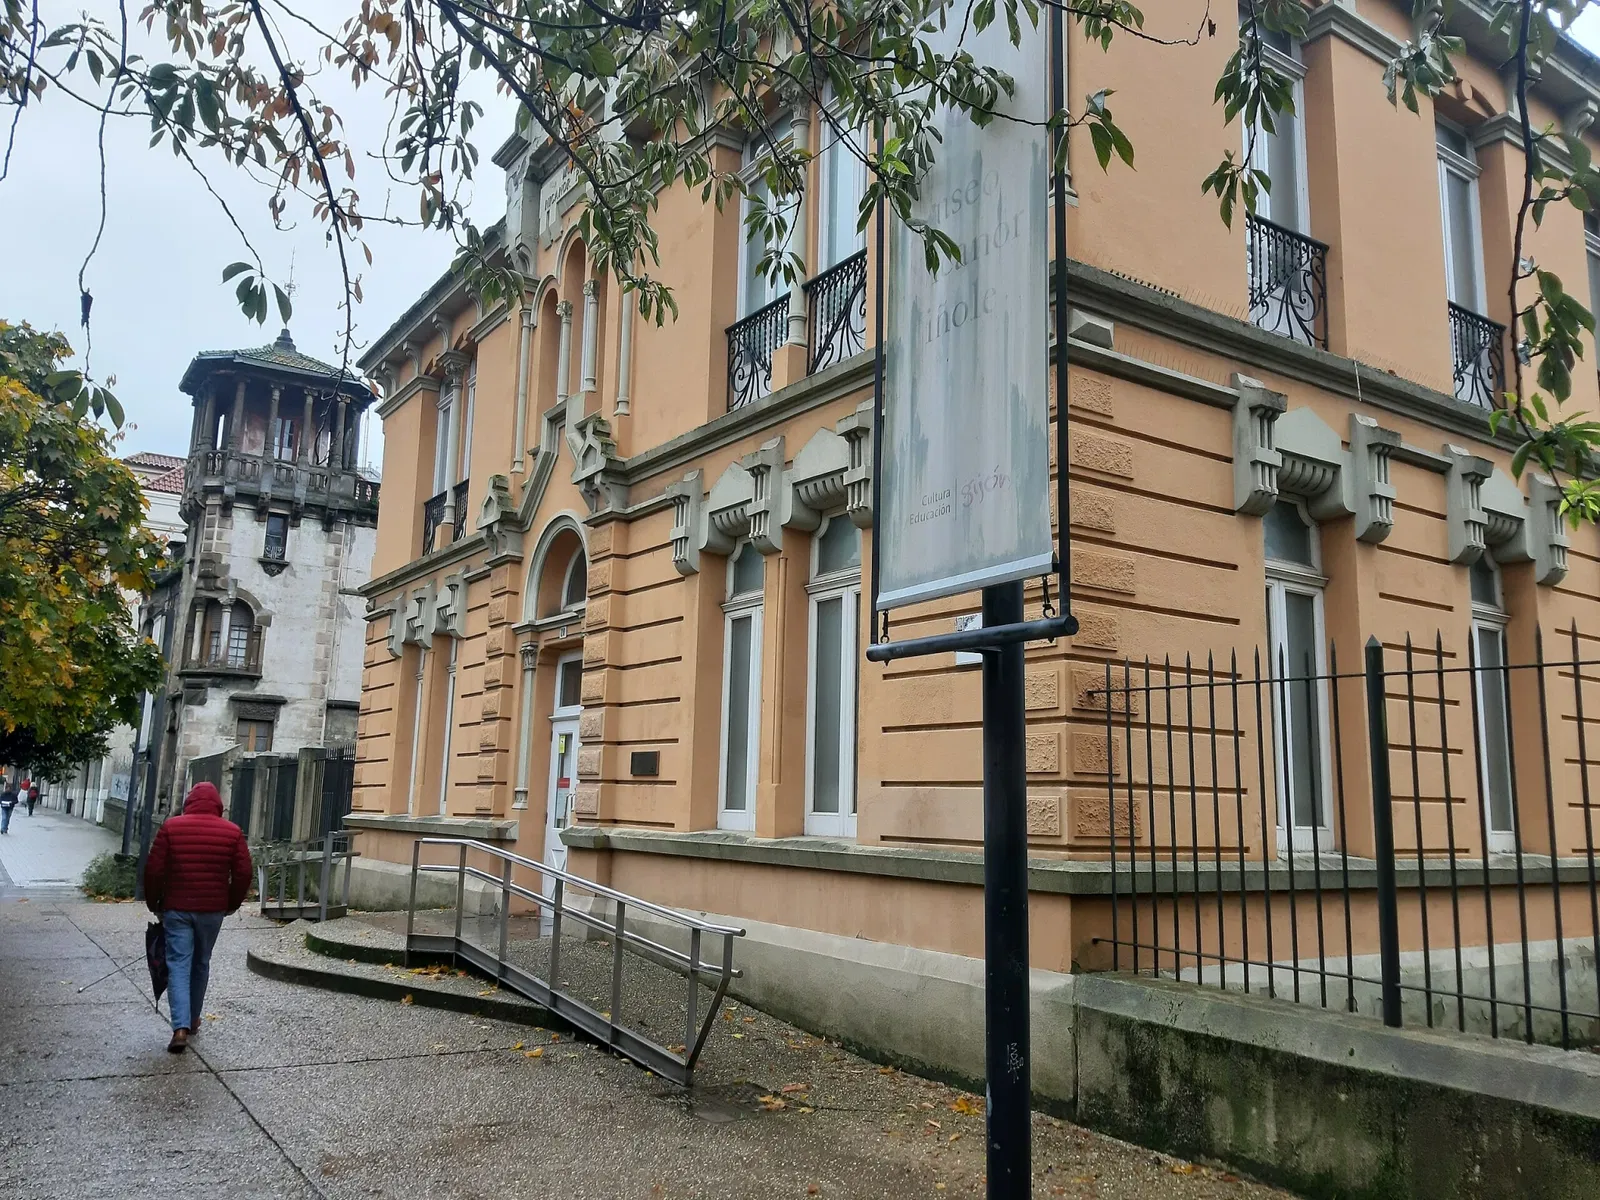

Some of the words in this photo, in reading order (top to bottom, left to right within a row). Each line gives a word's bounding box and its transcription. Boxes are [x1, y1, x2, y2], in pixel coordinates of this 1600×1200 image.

[928, 170, 999, 226] useo
[923, 277, 997, 345] iñole
[909, 503, 951, 525] Educación
[920, 488, 951, 507] Cultura
